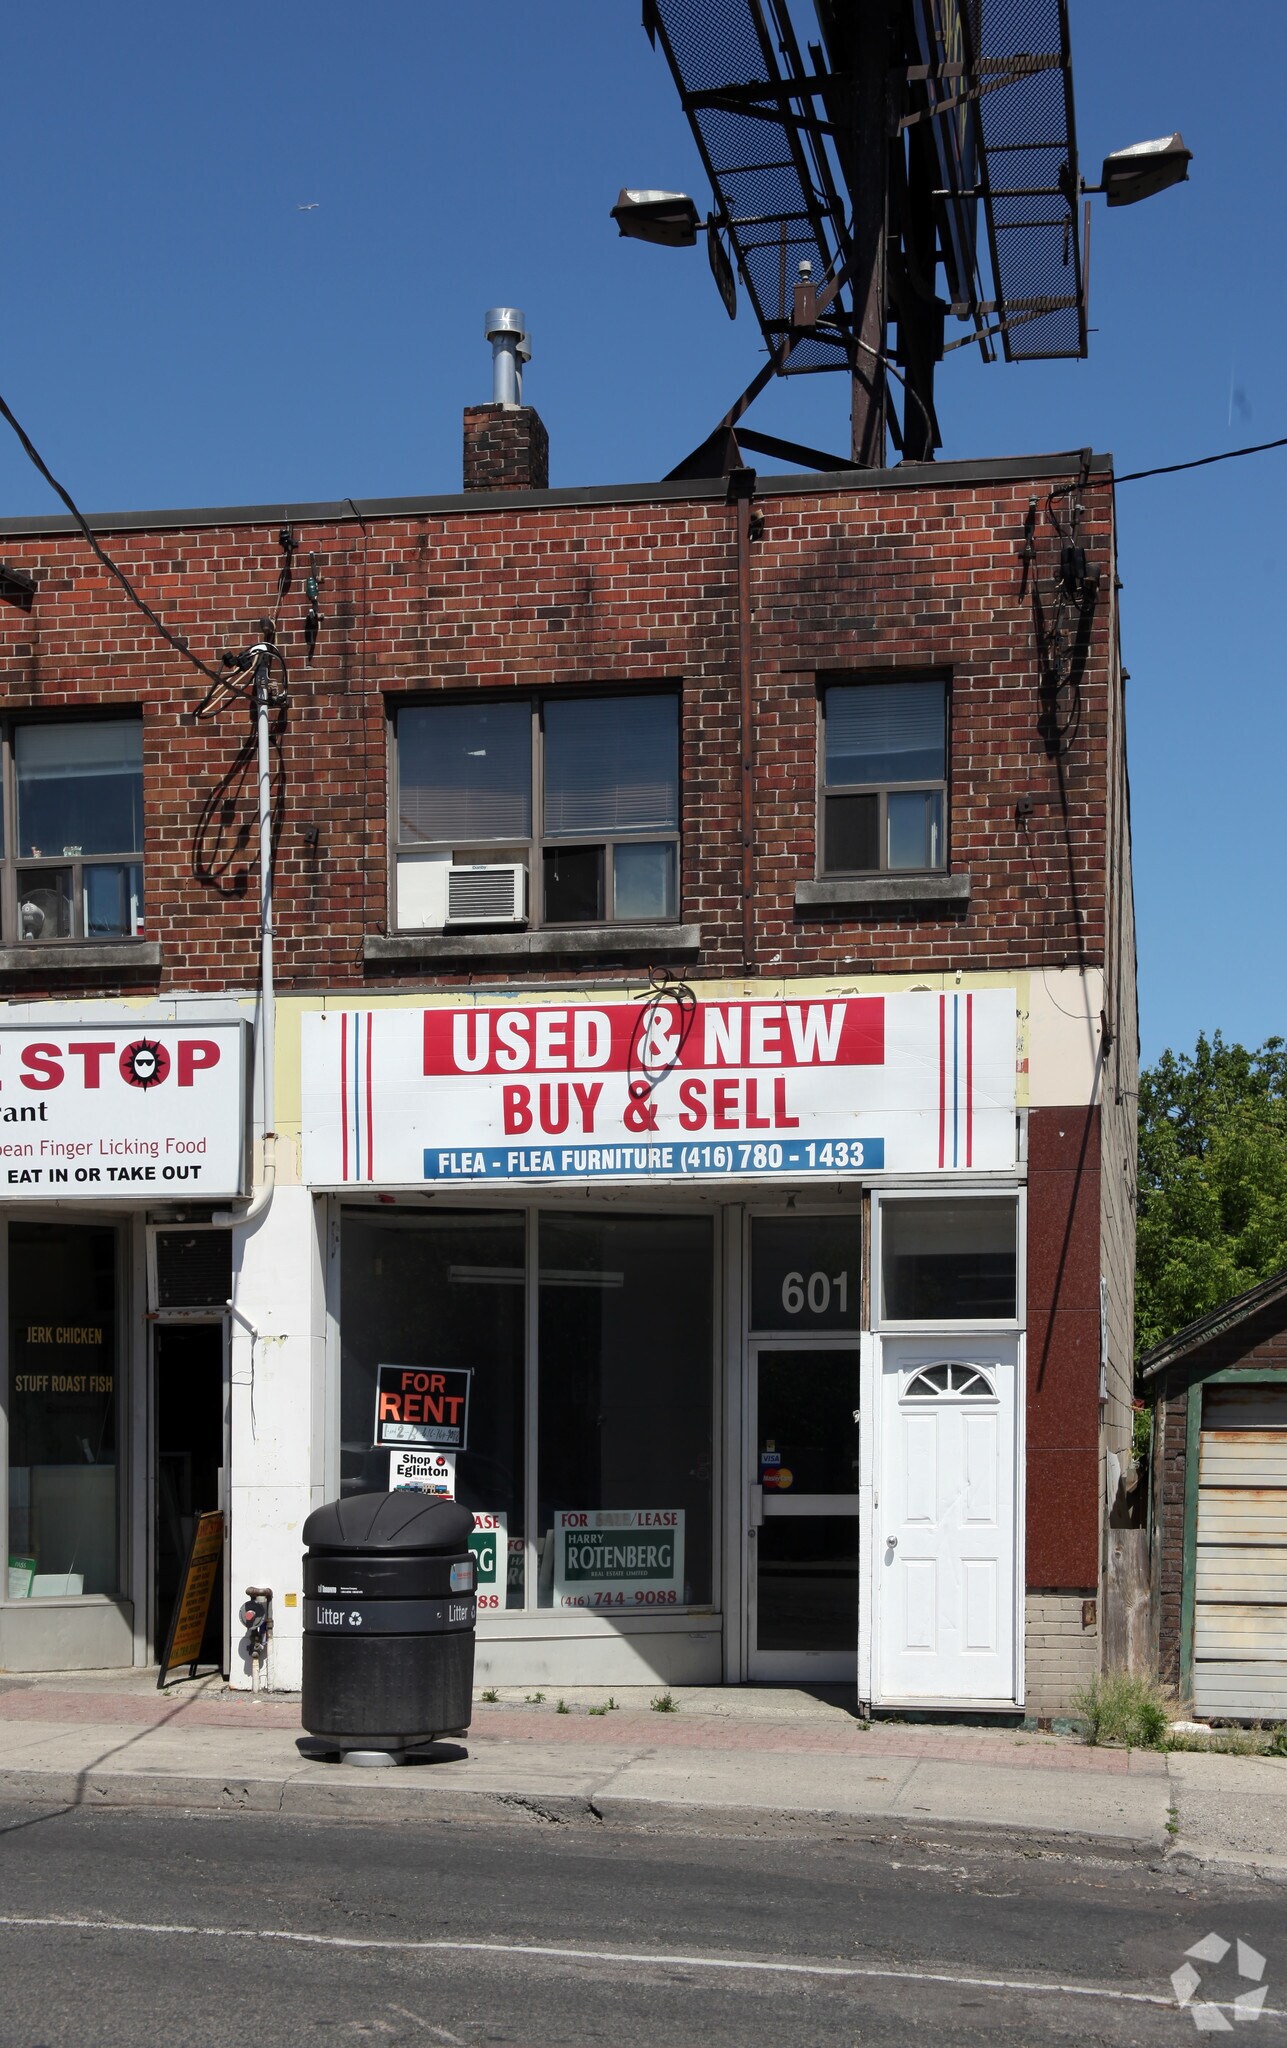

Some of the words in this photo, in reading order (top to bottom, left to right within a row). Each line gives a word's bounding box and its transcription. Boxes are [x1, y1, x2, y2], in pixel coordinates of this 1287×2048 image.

[452, 1010, 613, 1073] USED
[637, 1006, 683, 1068] &
[703, 1003, 848, 1066] NEW
[19, 1039, 221, 1091] STOP
[502, 1082, 604, 1136] BUY
[623, 1079, 659, 1133] &
[678, 1077, 800, 1132] SELL
[40, 1139, 93, 1160] Finger
[99, 1138, 160, 1158] Licking
[165, 1136, 207, 1154] Food
[438, 1152, 487, 1174] FLEA
[507, 1151, 555, 1173] FLEA
[561, 1146, 673, 1172] FURNITURE
[680, 1146, 734, 1173] (416)
[738, 1143, 783, 1169] 780
[804, 1141, 865, 1166] 1433
[7, 1168, 43, 1184] EAT
[49, 1168, 68, 1183] IN
[74, 1167, 102, 1182] OR
[106, 1166, 157, 1181] TAKE
[162, 1165, 202, 1180] OUT
[781, 1271, 848, 1314] 601
[26, 1326, 53, 1344] JERK
[55, 1326, 103, 1344] CHICKEN
[15, 1375, 49, 1393] STUFF
[51, 1375, 87, 1392] ROAST
[89, 1375, 113, 1393] FISH
[401, 1372, 446, 1394] FOR
[379, 1391, 464, 1425] RENT
[402, 1453, 431, 1467] Shop
[763, 1455, 780, 1463] VISA
[396, 1463, 449, 1478] Eglinton
[561, 1513, 588, 1528] FOR
[568, 1533, 604, 1544] HARRY
[567, 1544, 672, 1570] ROTENBERG
[560, 1594, 591, 1607] (416)
[594, 1590, 678, 1606] 744-9088
[316, 1606, 346, 1626] Litter
[448, 1604, 469, 1623] Litter
